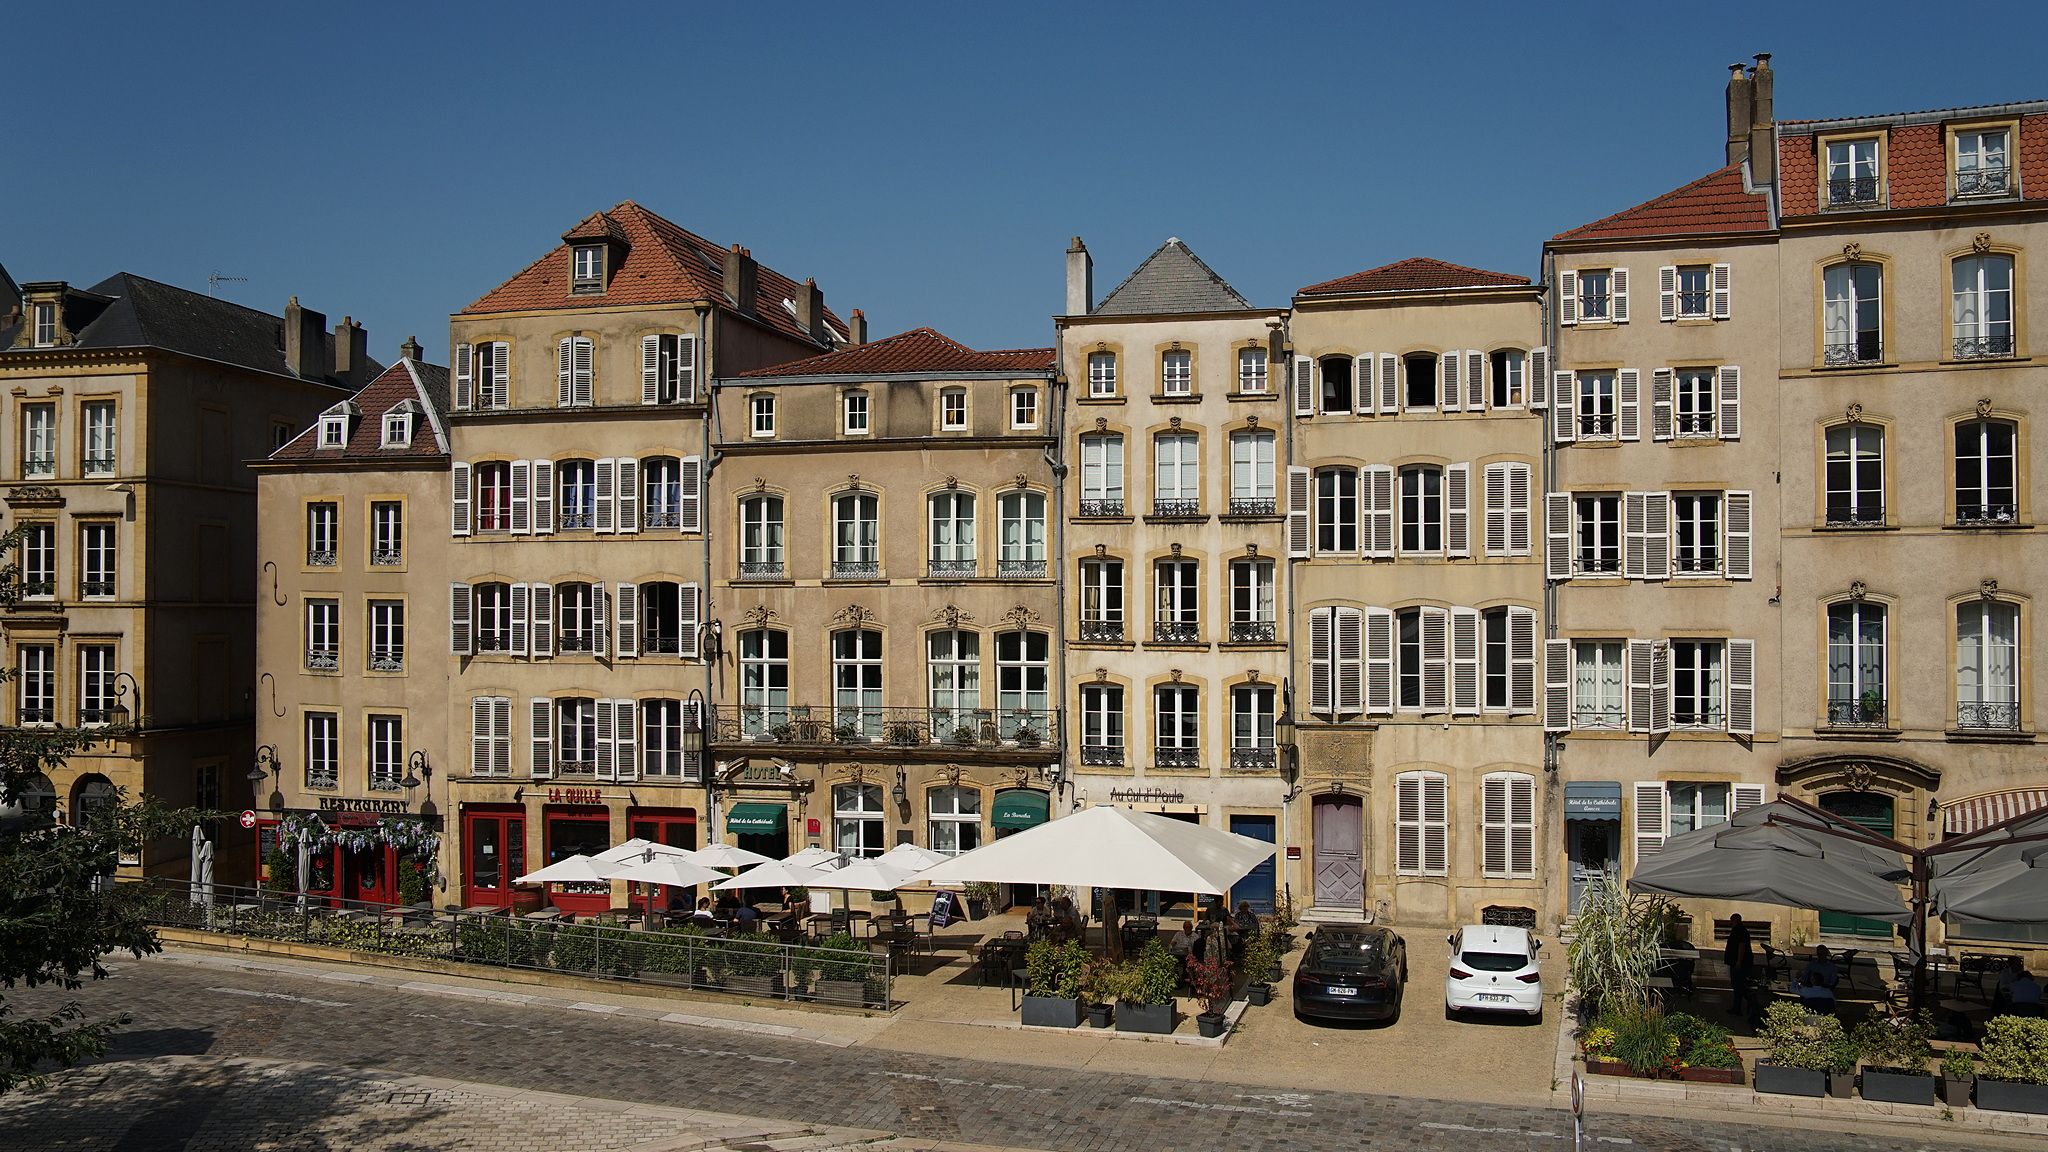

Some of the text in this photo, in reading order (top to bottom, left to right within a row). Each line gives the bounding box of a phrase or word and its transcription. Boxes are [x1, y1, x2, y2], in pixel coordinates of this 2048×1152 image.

[549, 788, 602, 804] LA QUILLE
[1110, 787, 1123, 802] Au
[1127, 787, 1141, 802] Cul
[1155, 787, 1184, 803] Poule
[319, 798, 409, 813] RESTAURANT
[1928, 832, 1935, 840] 17
